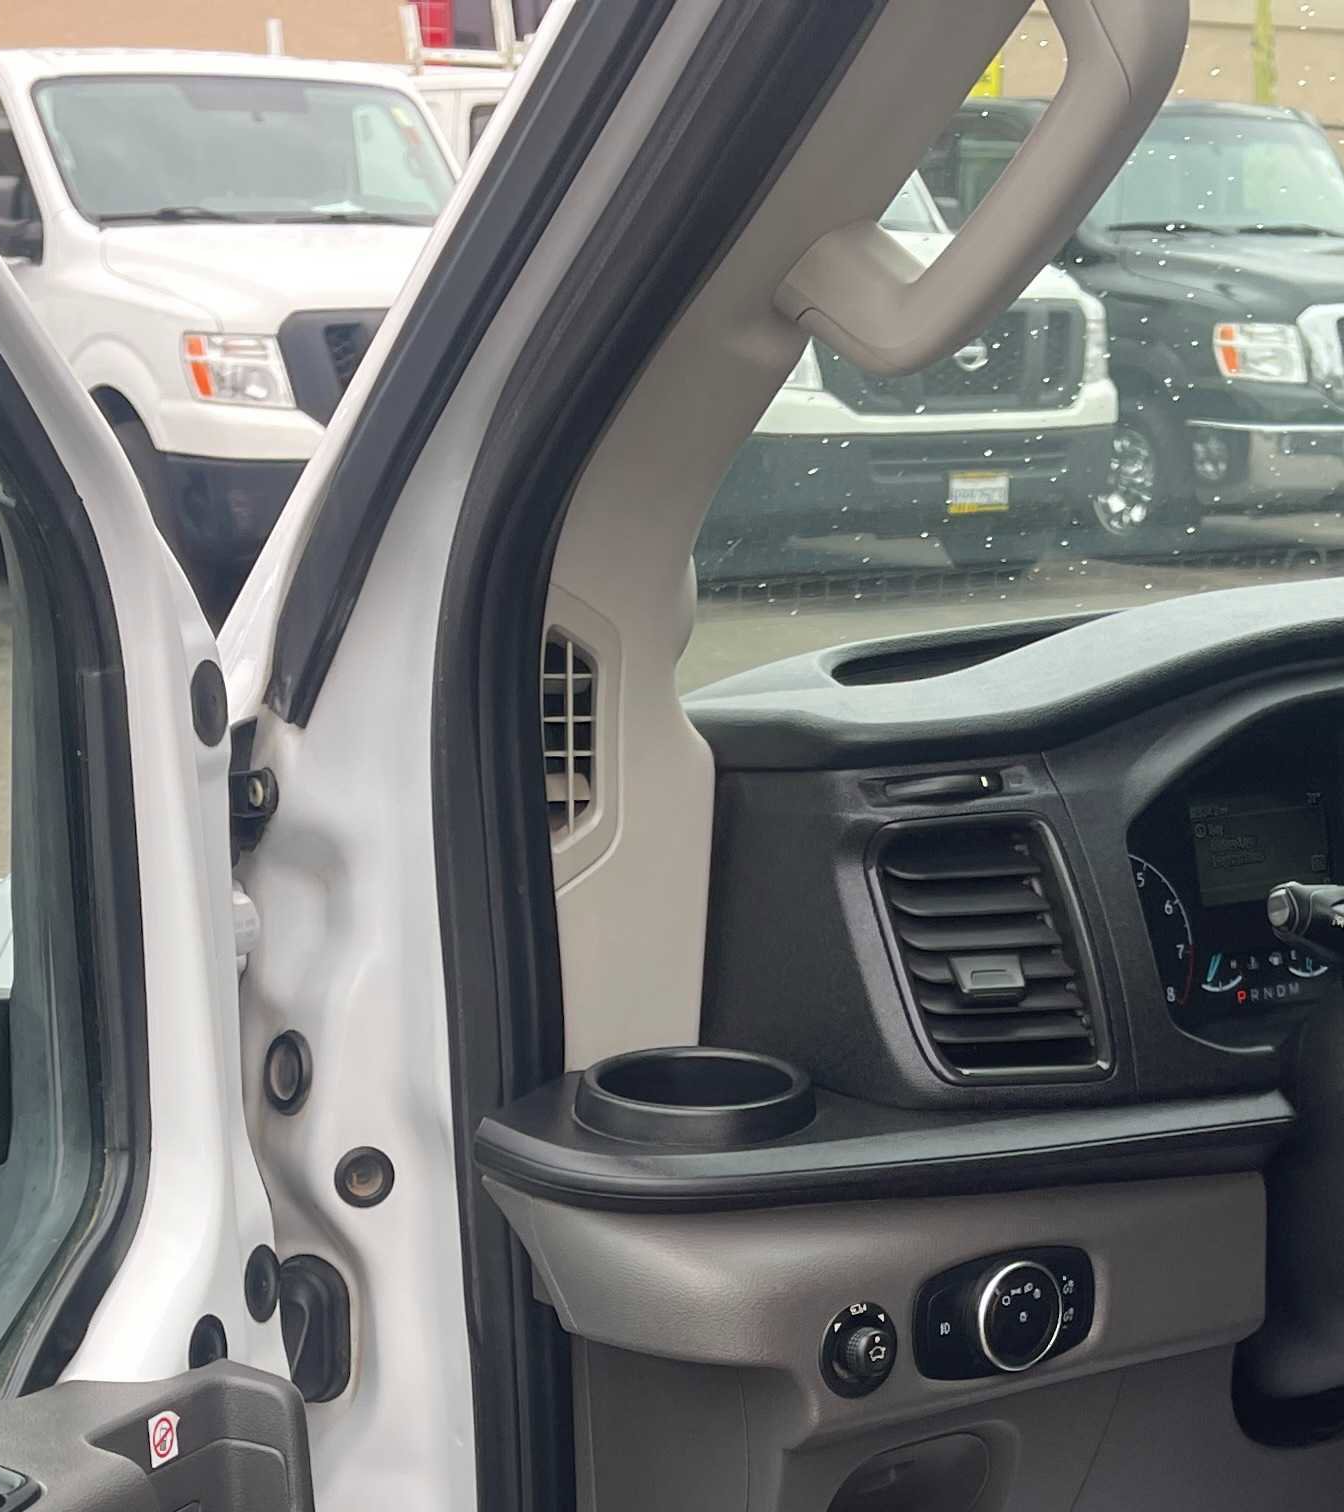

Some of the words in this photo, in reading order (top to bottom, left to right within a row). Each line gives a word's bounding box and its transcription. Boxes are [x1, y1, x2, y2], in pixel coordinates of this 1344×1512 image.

[1163, 902, 1174, 915] 6
[1175, 944, 1185, 960] 7
[1166, 987, 1176, 1003] 8
